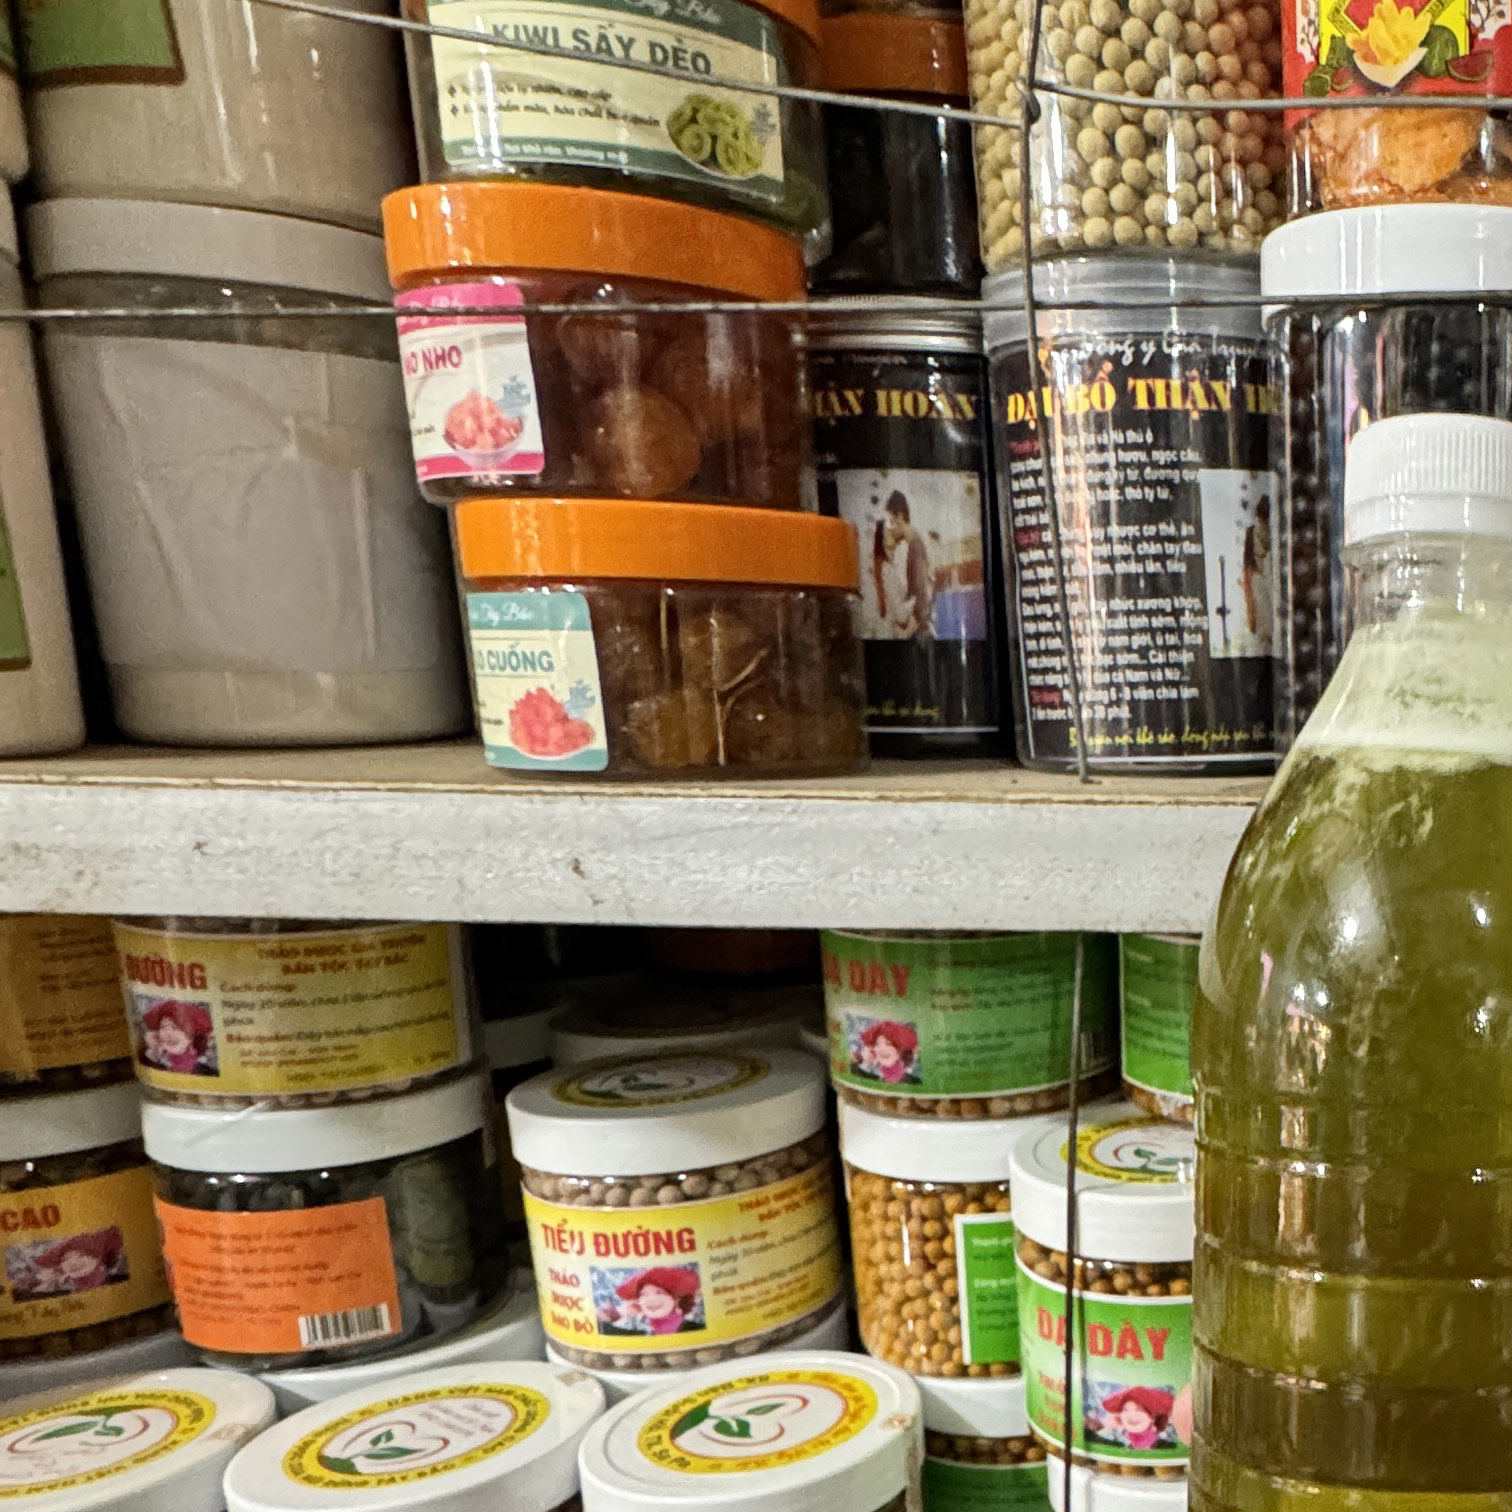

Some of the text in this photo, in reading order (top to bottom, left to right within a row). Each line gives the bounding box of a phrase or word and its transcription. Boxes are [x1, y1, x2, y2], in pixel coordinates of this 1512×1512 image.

[422, 345, 462, 372] NHO
[487, 641, 555, 673] CUỐNG
[1, 1204, 60, 1233] CAO
[541, 1219, 697, 1259] TIỂU ĐƯỜNG
[1088, 1319, 1170, 1361] DÀY
